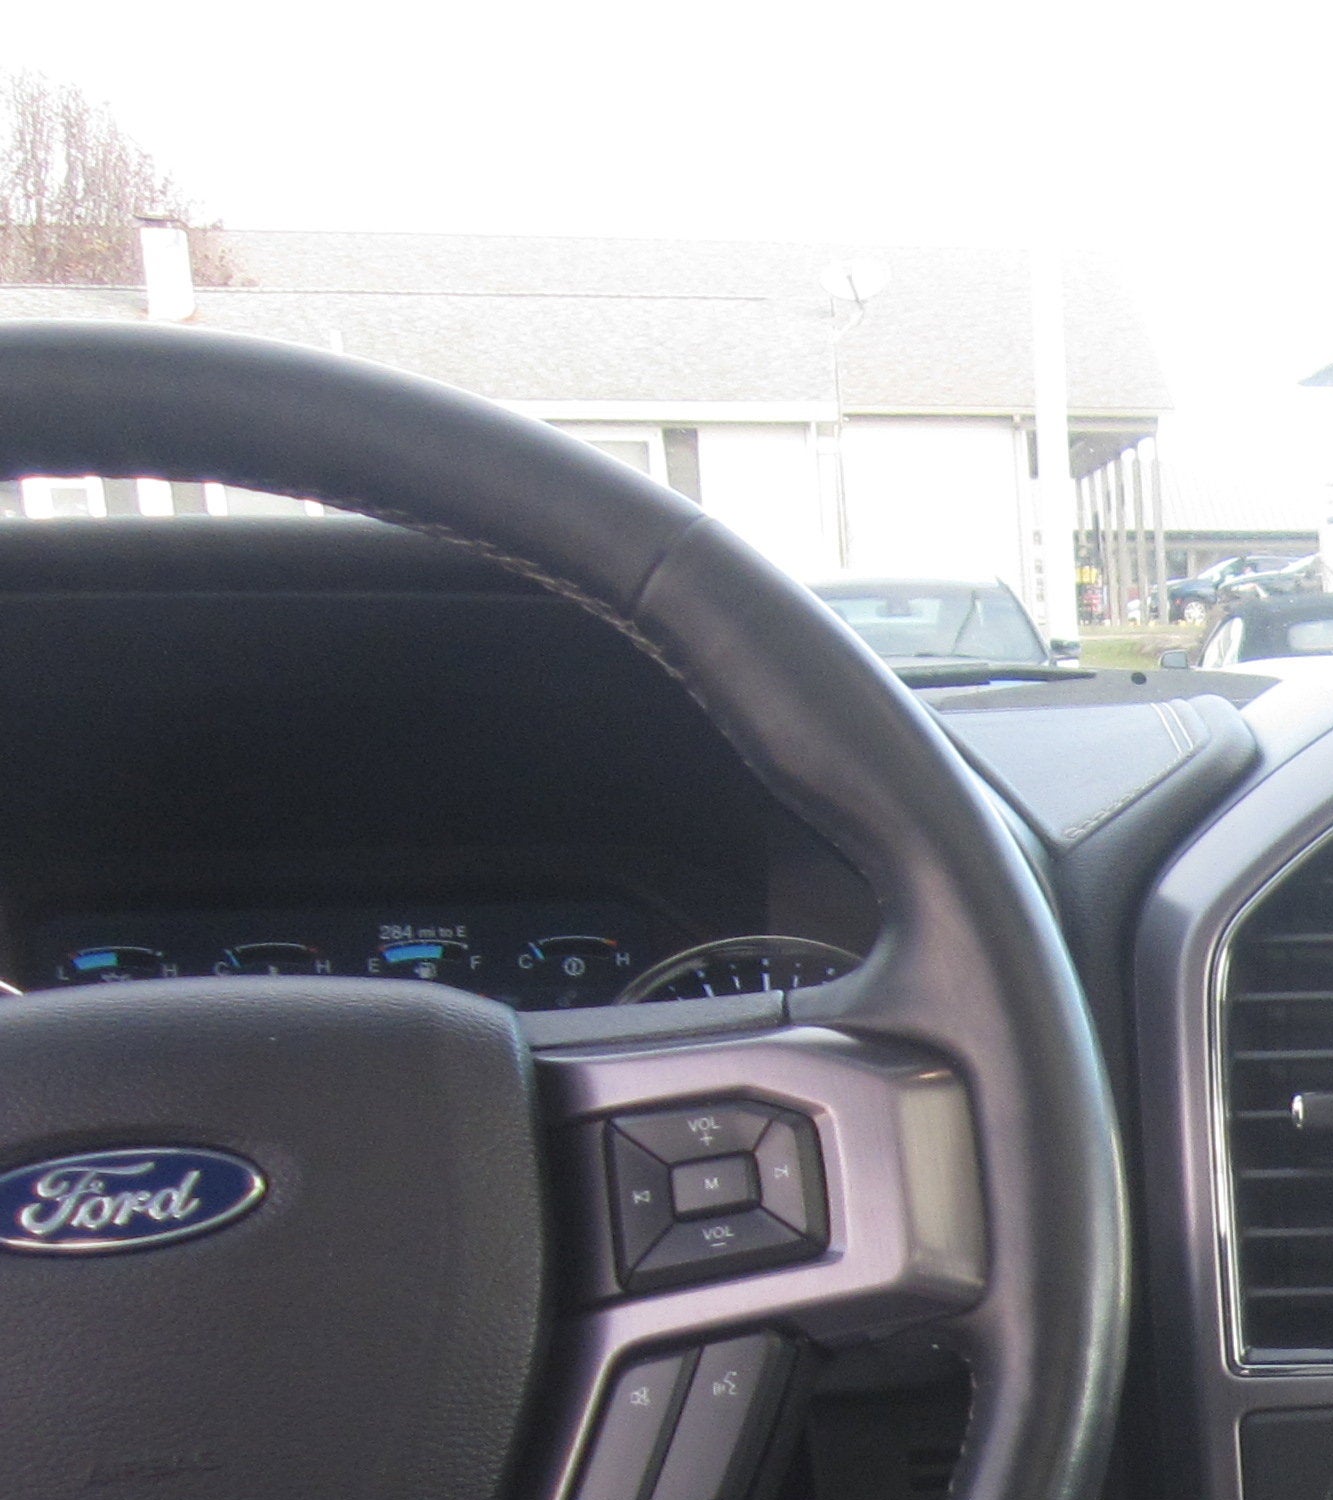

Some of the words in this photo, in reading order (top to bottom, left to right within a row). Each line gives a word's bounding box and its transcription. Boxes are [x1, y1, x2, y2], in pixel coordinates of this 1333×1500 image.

[367, 958, 380, 973] E
[469, 955, 481, 970] F
[517, 953, 534, 970] C
[615, 952, 630, 967] H
[687, 1116, 720, 1132] VOL
[20, 1161, 201, 1235] Ford
[702, 1225, 735, 1240] VOL
